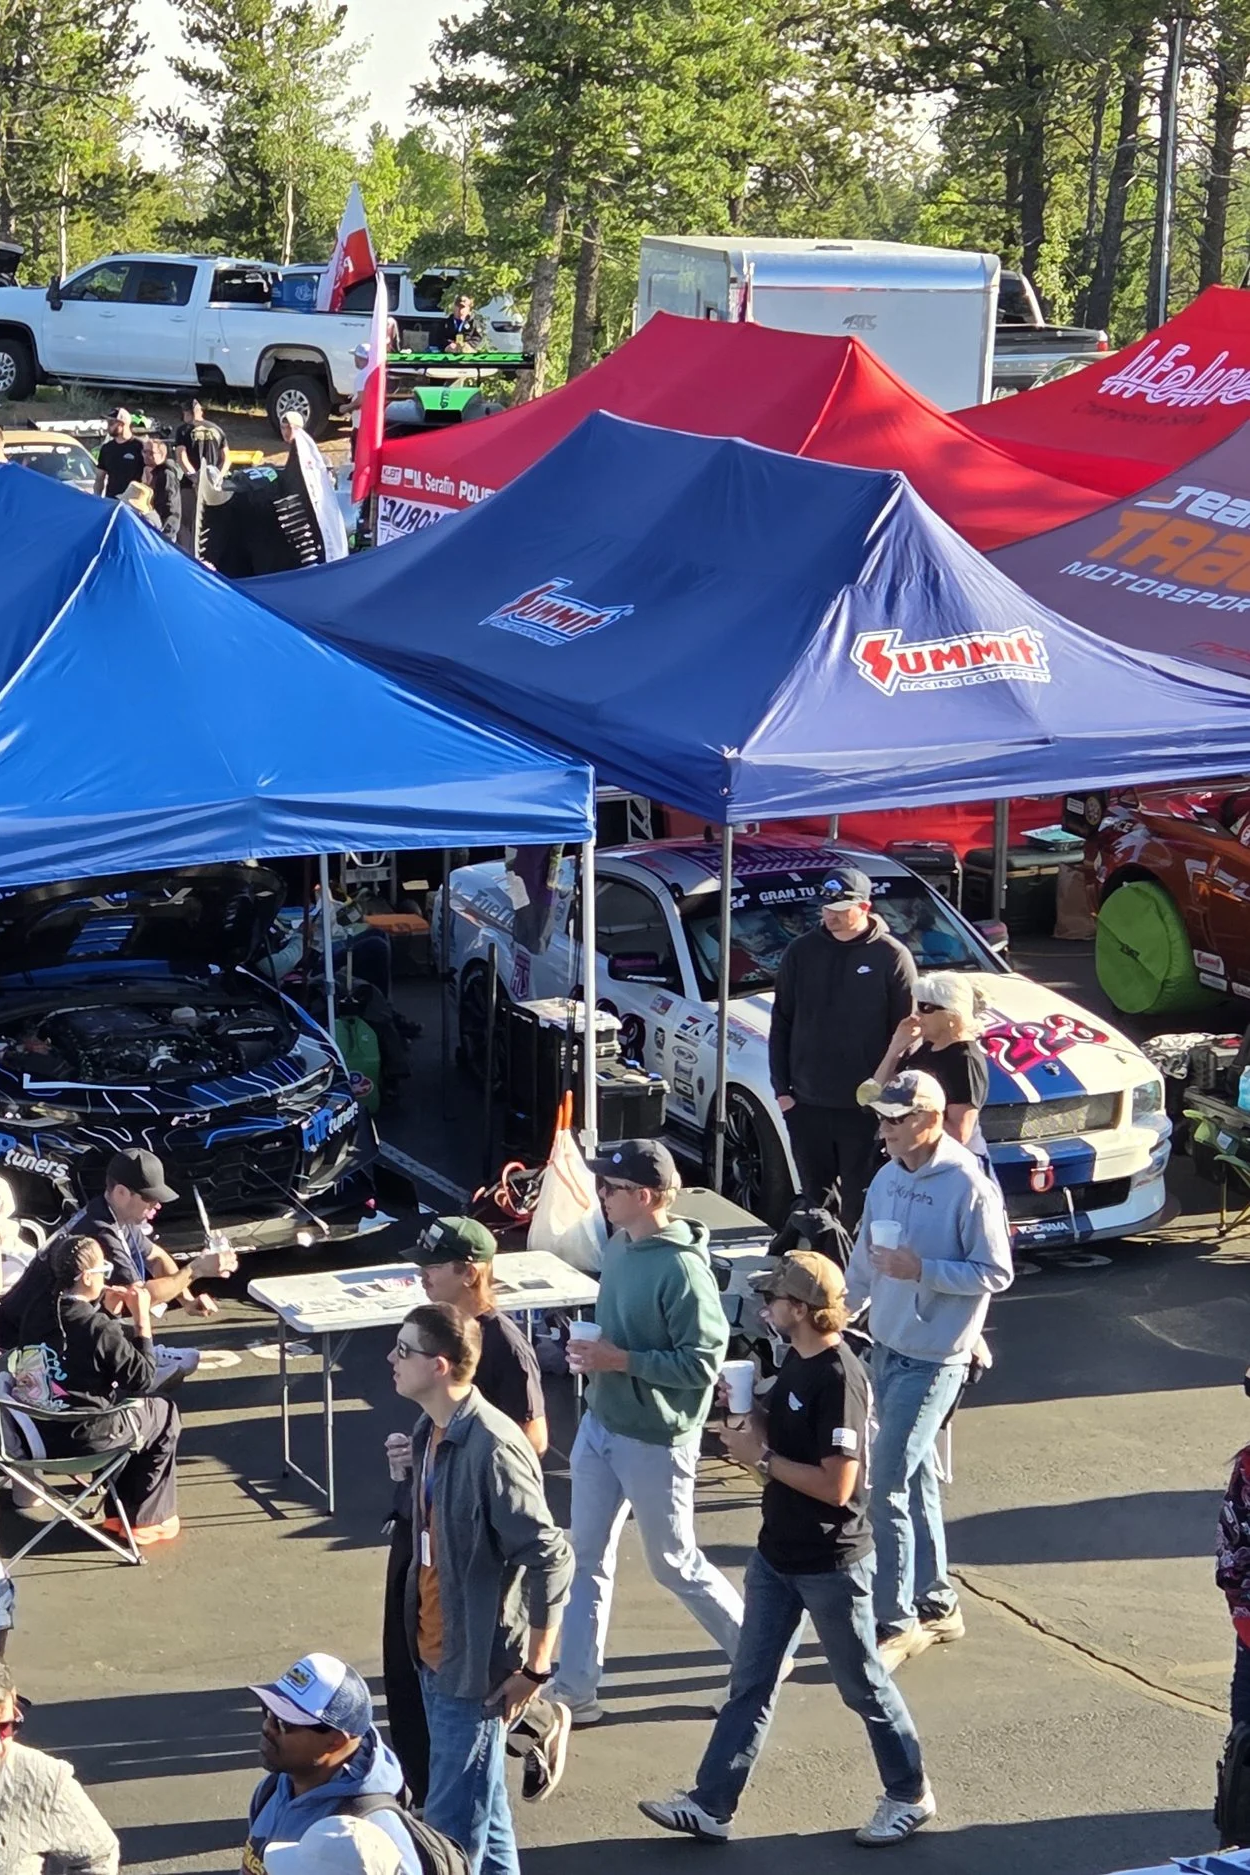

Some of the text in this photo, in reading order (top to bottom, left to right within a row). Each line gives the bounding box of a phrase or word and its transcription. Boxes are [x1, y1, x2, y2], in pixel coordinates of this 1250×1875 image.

[425, 472, 455, 496] Serafin
[1134, 485, 1250, 529] Tea
[902, 670, 1050, 691] RACING EQUIPMENT
[759, 889, 796, 903] GRAN
[303, 1108, 334, 1152] HP
[4, 1148, 70, 1178] tuners
[1016, 1222, 1069, 1234] YOKOHAMA
